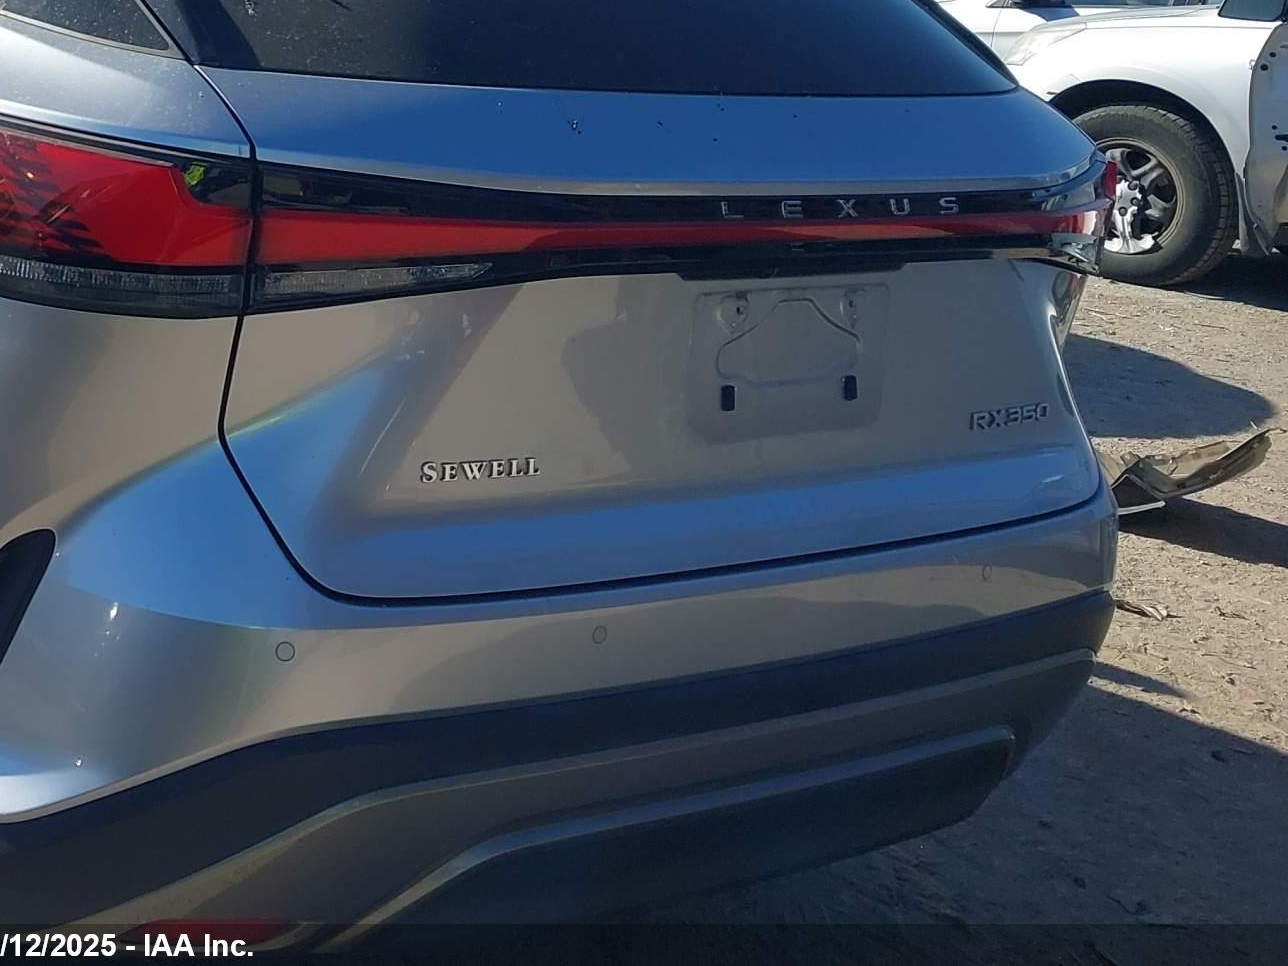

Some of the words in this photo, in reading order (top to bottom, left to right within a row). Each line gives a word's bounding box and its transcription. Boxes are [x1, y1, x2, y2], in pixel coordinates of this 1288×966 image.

[720, 196, 960, 219] LEXUS
[969, 403, 1049, 430] RX350
[419, 457, 541, 483] SEWELL
